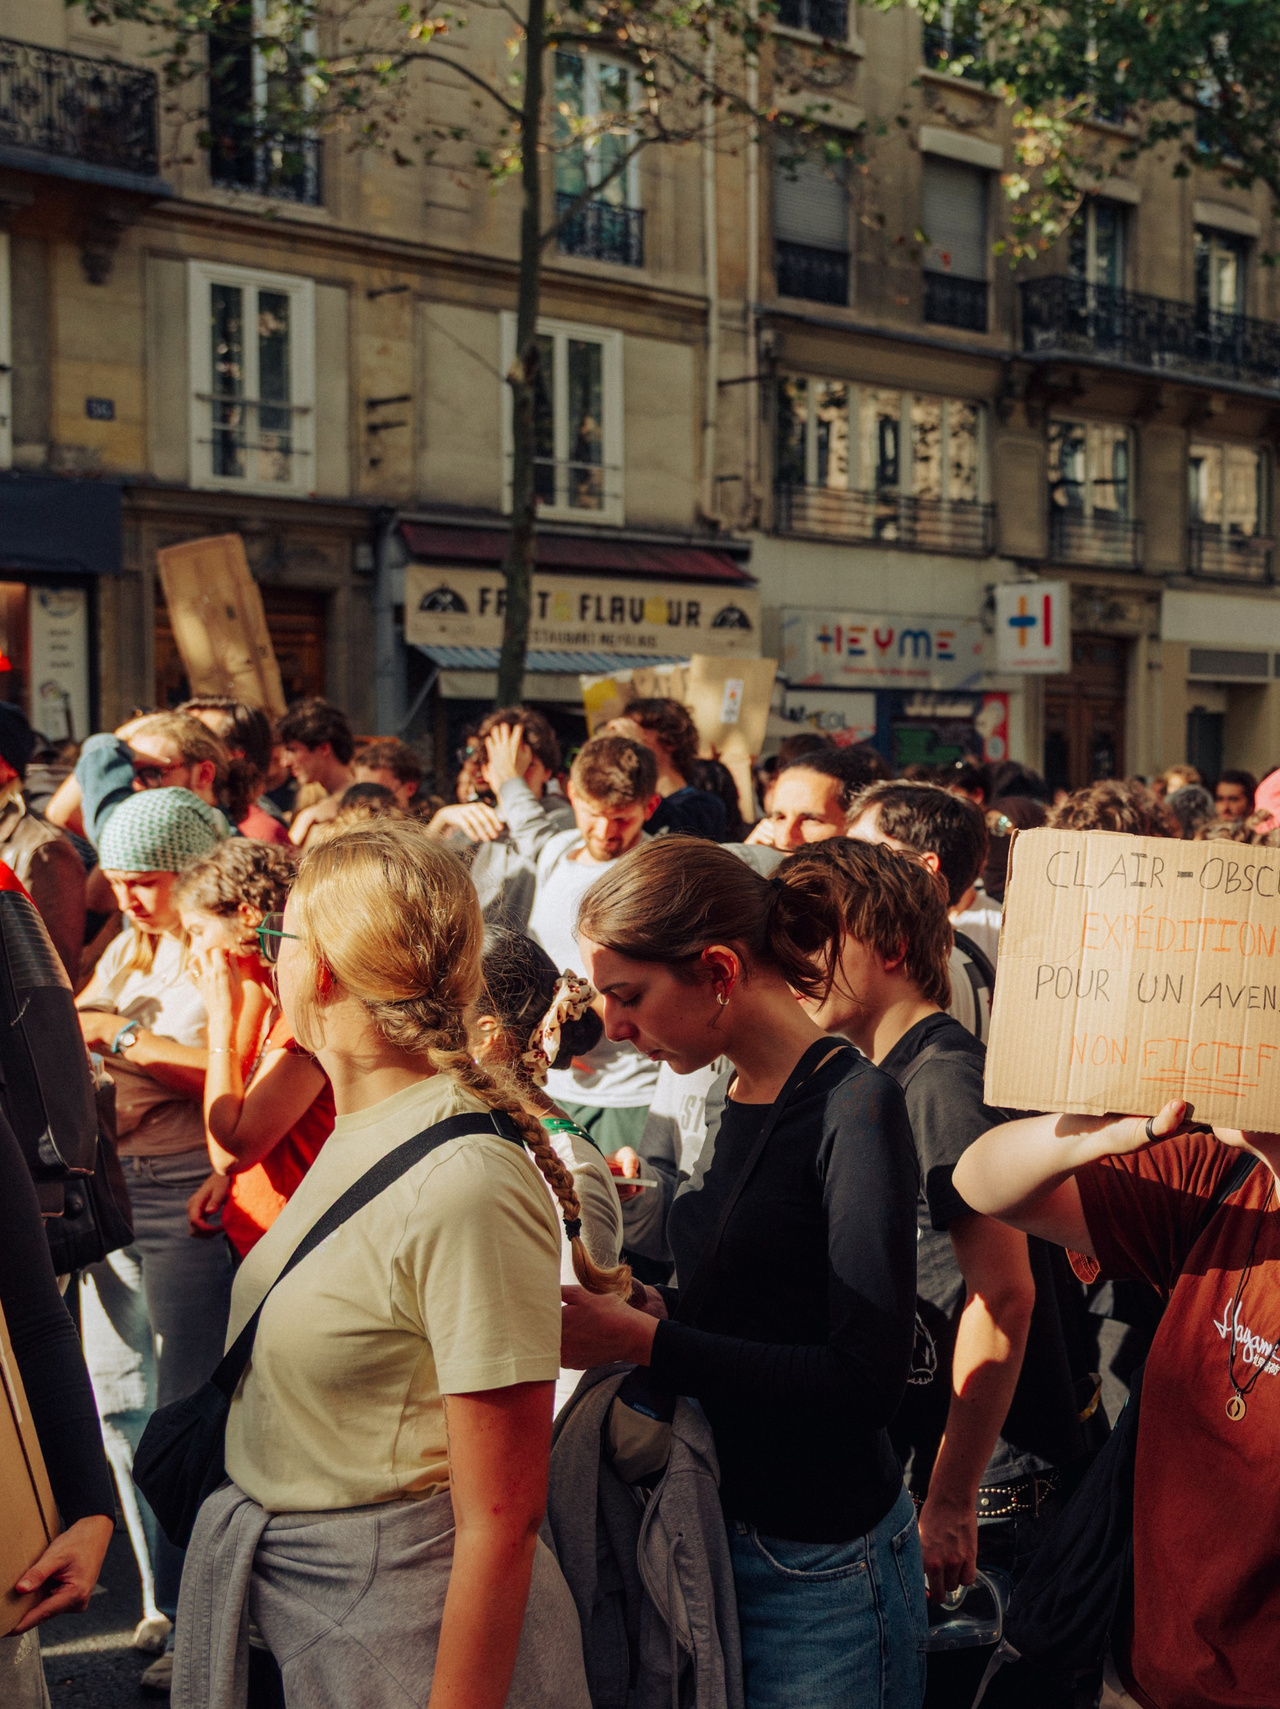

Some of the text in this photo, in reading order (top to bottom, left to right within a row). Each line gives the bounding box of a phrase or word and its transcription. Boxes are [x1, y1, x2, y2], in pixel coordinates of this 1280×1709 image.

[478, 588, 551, 620] FRT
[580, 593, 700, 627] FLAVOUR
[816, 623, 955, 661] HEYME
[1081, 904, 1277, 957] EXPÉDITION
[1035, 964, 1110, 1002] POUR
[1137, 972, 1184, 1004] UN
[1069, 1032, 1280, 1078] NON FICTIF
